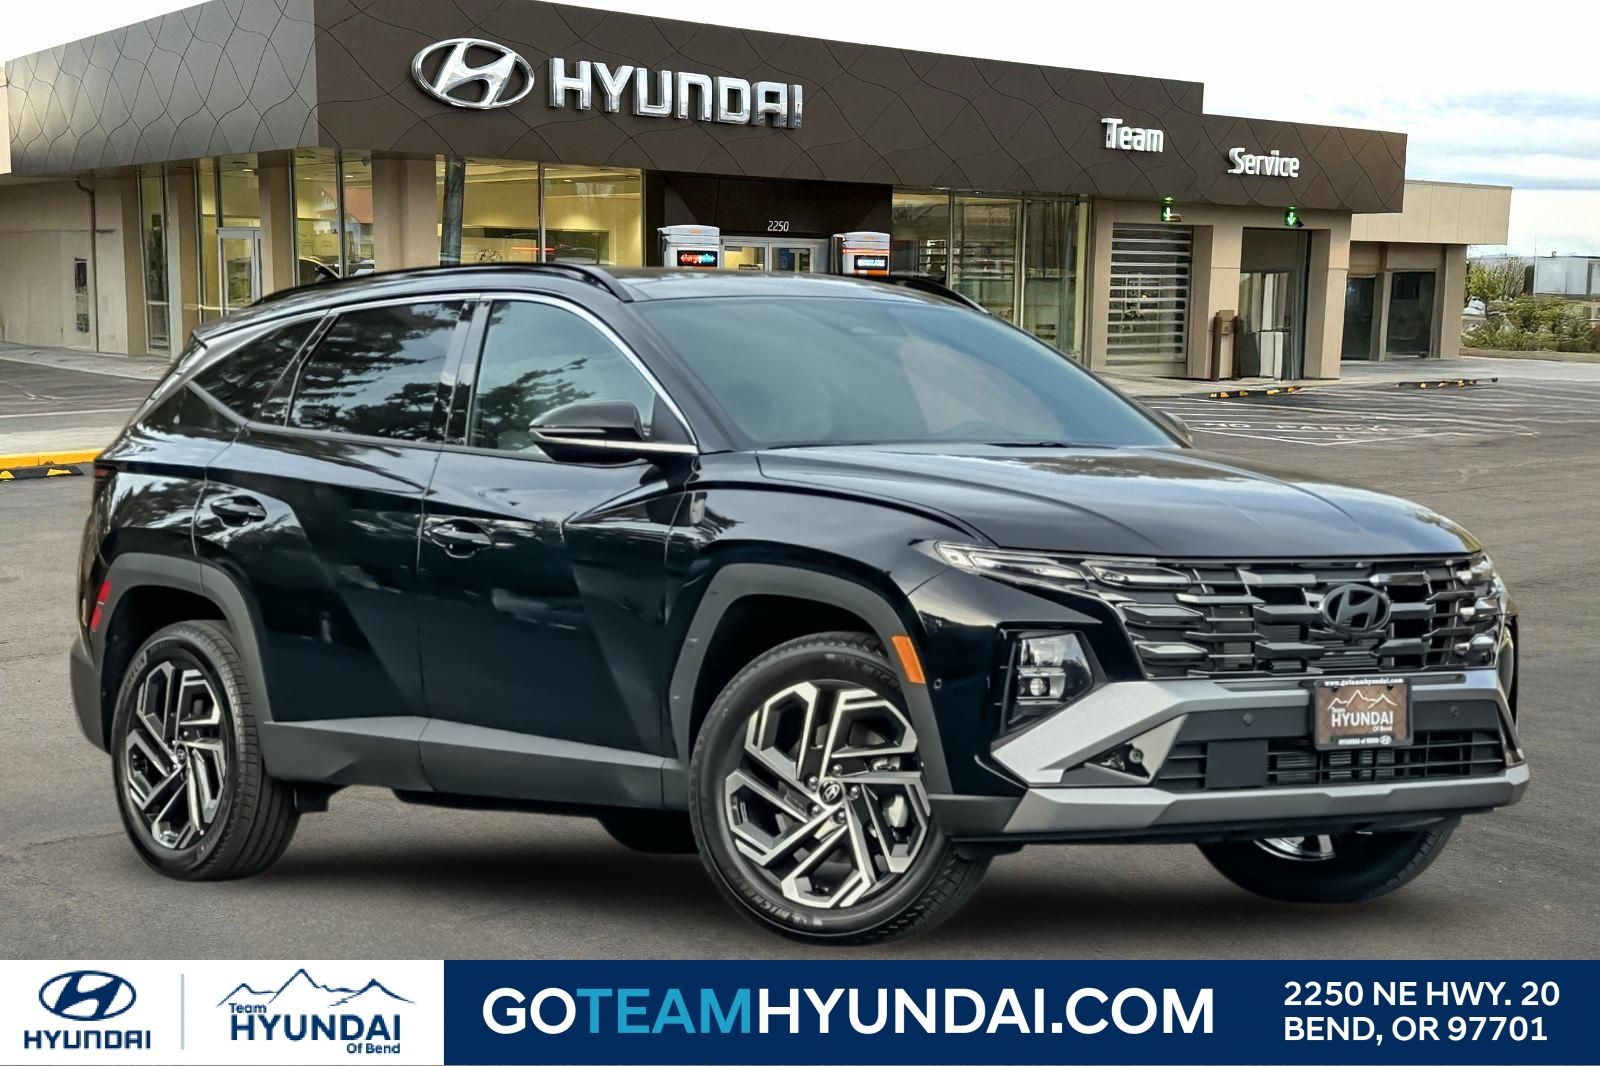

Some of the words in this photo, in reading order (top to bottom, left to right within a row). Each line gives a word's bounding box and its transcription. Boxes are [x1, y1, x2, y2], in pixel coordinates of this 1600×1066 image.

[549, 57, 803, 129] HYUNDAI
[1101, 117, 1164, 152] Team
[1227, 147, 1300, 177] Service
[767, 220, 790, 232] 2250
[1331, 711, 1393, 727] HYUNDAI
